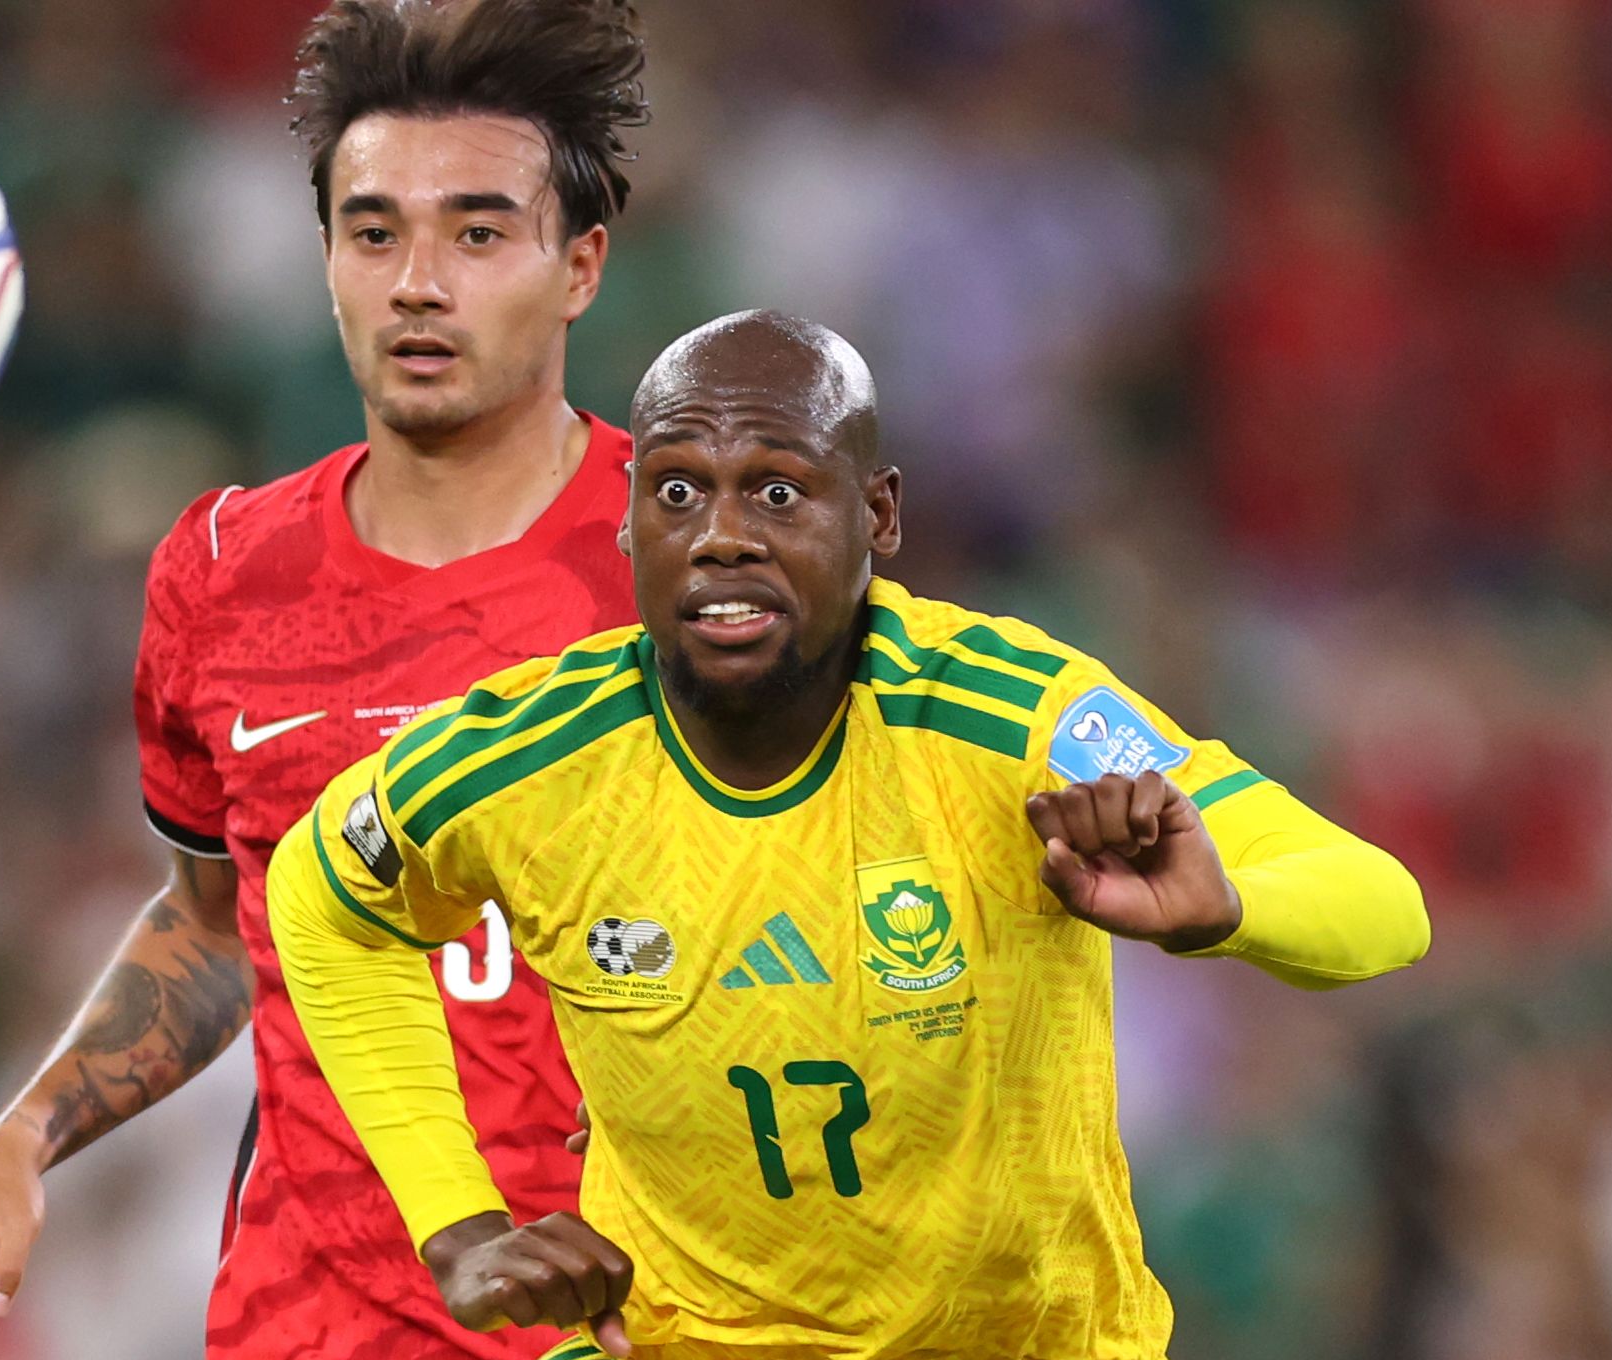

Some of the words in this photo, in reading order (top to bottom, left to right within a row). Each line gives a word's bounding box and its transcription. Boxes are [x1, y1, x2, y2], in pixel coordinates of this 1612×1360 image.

[601, 978, 629, 988] SOUTH
[631, 981, 667, 991] AFRICAN
[886, 975, 925, 989] SOUTH
[927, 963, 963, 987] AFRICA
[586, 985, 627, 997] FOOTBALL
[629, 991, 684, 1002] ASSOCIATION
[726, 1060, 871, 1199] 17
